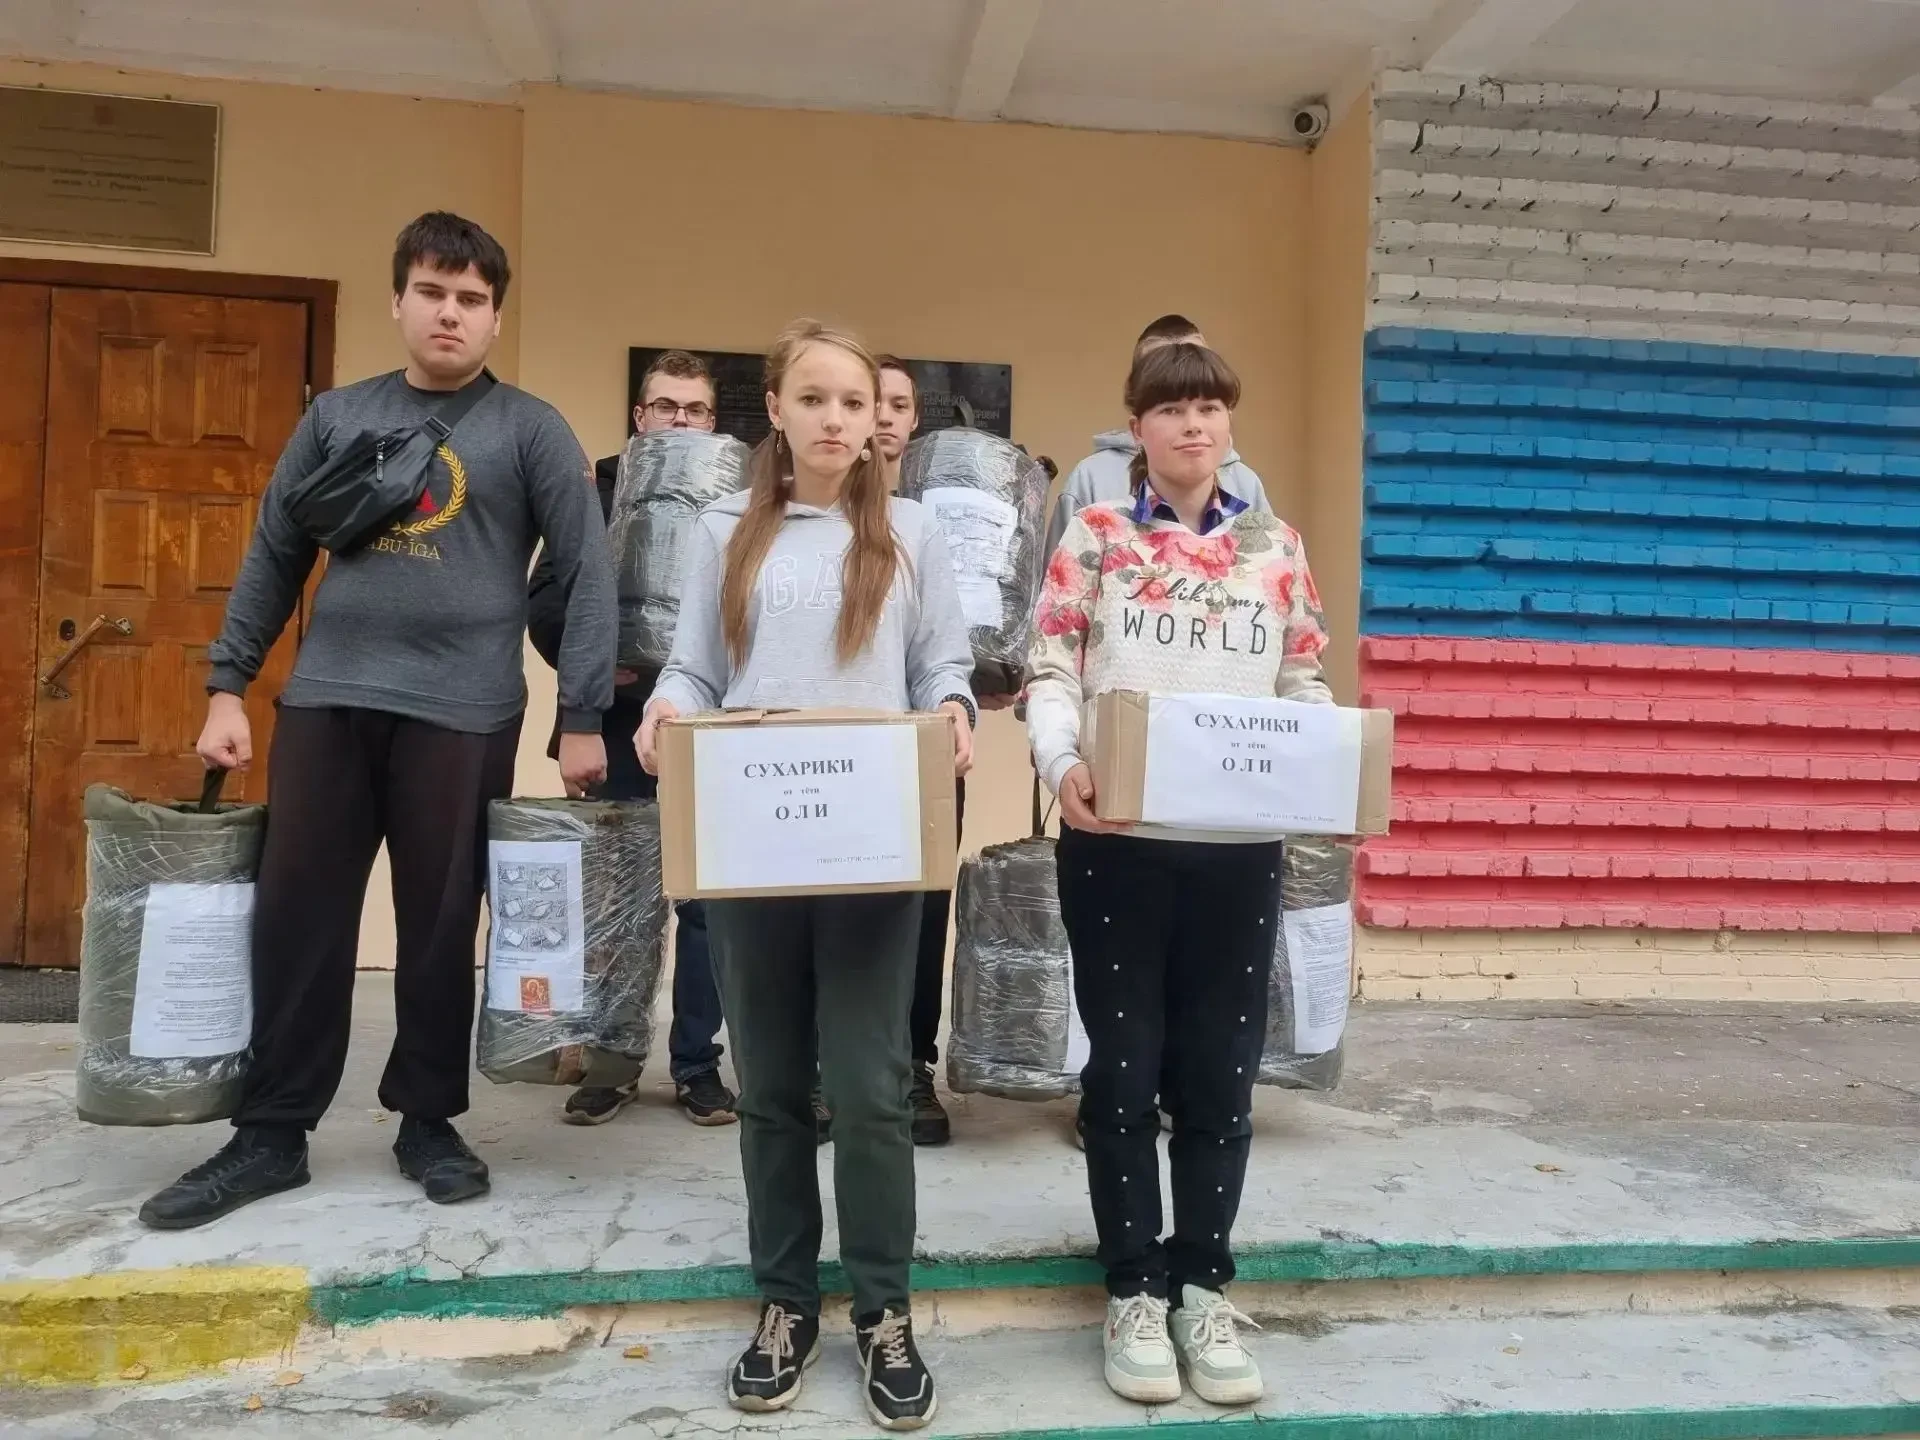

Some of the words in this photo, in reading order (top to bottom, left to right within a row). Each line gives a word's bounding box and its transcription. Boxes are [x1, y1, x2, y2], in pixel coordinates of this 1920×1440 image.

[1164, 577, 1214, 607] like
[1231, 600, 1268, 624] my
[1124, 607, 1267, 655] WORLD
[1194, 713, 1299, 733] СУХАРИКИ
[744, 758, 854, 778] СУХАРИКИ
[783, 788, 793, 796] от
